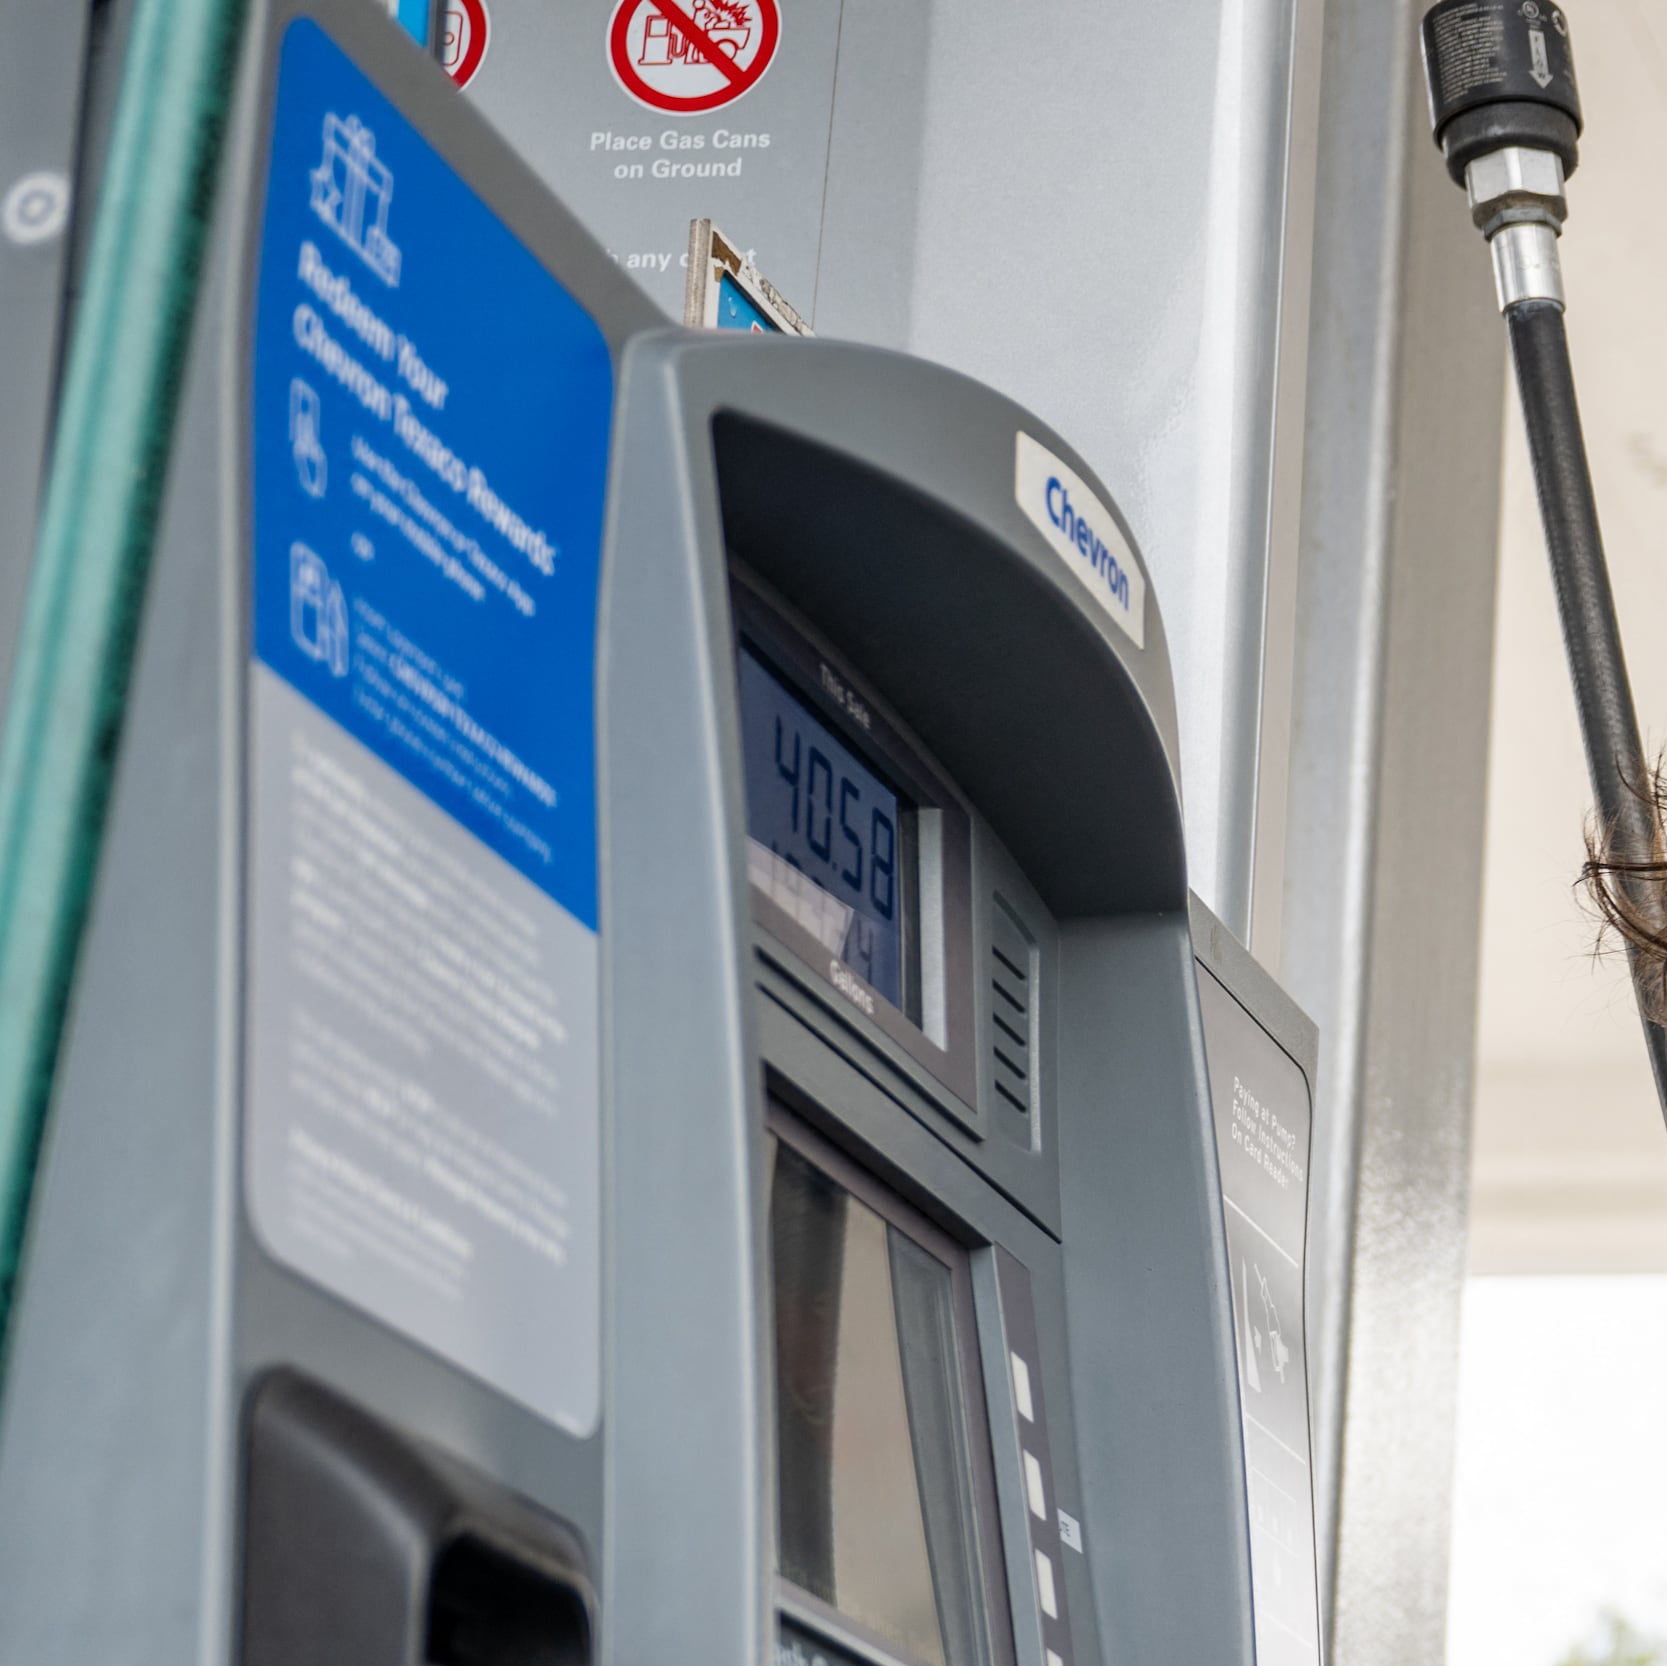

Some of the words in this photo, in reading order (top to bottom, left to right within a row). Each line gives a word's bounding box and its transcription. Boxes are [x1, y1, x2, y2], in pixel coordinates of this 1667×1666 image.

[590, 131, 651, 151] Place
[660, 130, 704, 150] Gas
[712, 129, 771, 149] Cans
[614, 164, 644, 179] on
[652, 157, 742, 178] Ground
[627, 252, 672, 272] any
[1045, 476, 1130, 611] Chevron
[820, 663, 845, 704] This
[846, 690, 871, 731] Sale
[1233, 1076, 1260, 1118] Paying
[1261, 1107, 1270, 1125] at
[1231, 1122, 1243, 1145] On
[1244, 1135, 1262, 1165] Card
[1232, 1099, 1257, 1135] Follow
[1258, 1124, 1304, 1182] Instructions
